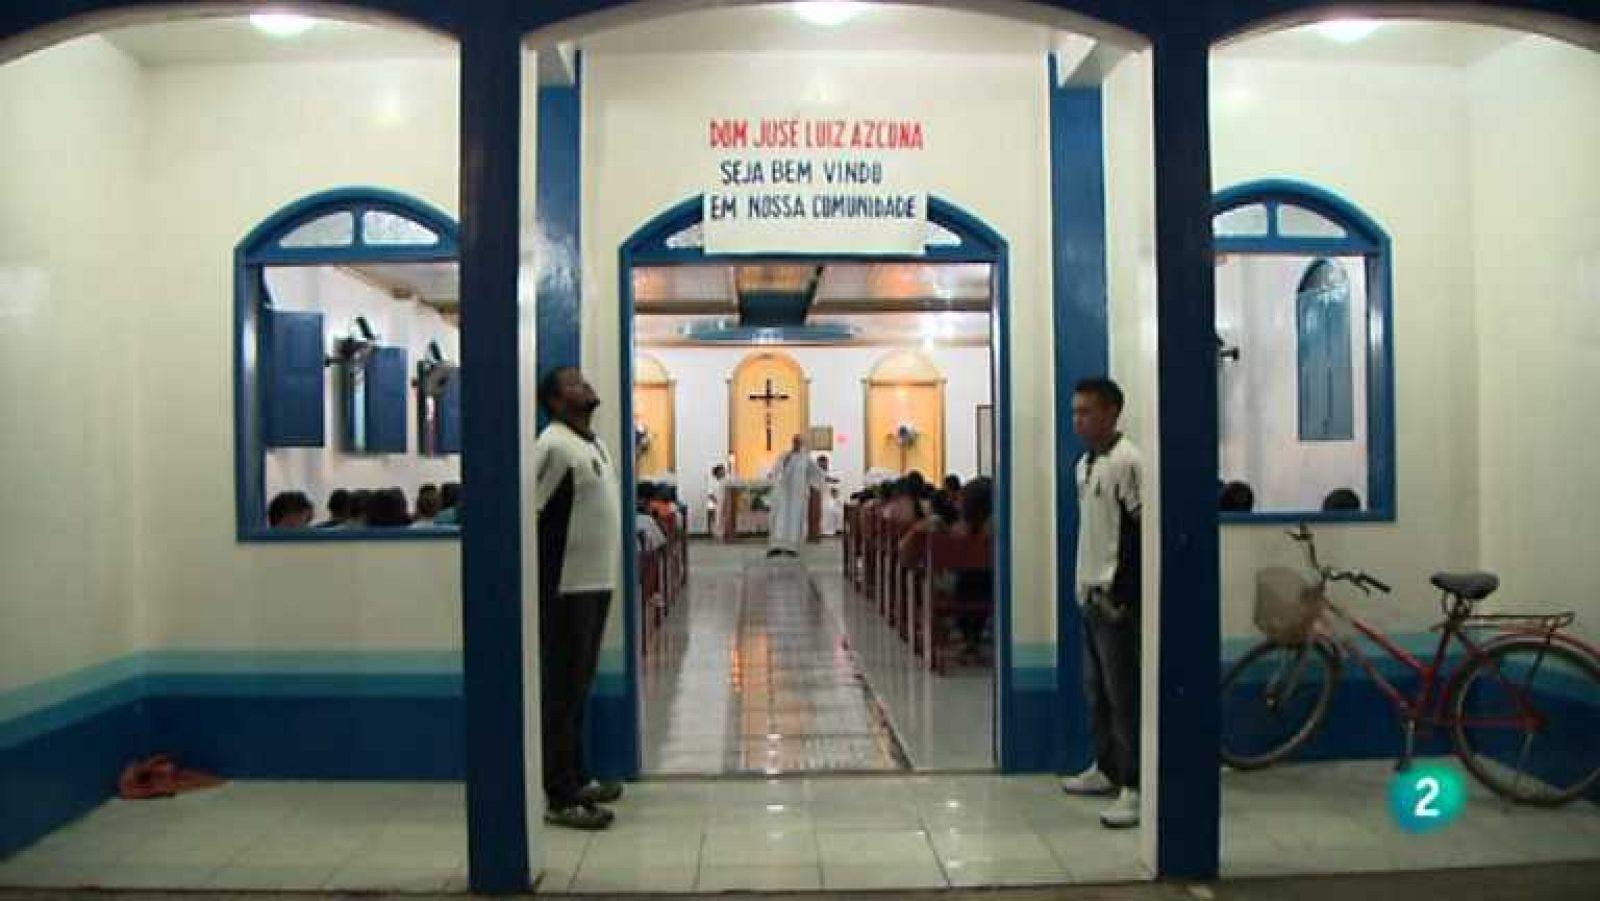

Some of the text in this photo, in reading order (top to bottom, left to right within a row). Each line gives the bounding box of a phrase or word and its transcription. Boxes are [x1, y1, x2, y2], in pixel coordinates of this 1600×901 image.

[805, 119, 846, 149] LUIZ
[851, 120, 924, 150] AZCONA
[720, 160, 883, 185] SEJA BEM VINDO
[711, 195, 917, 219] EM NOSSA COMUNIDADE
